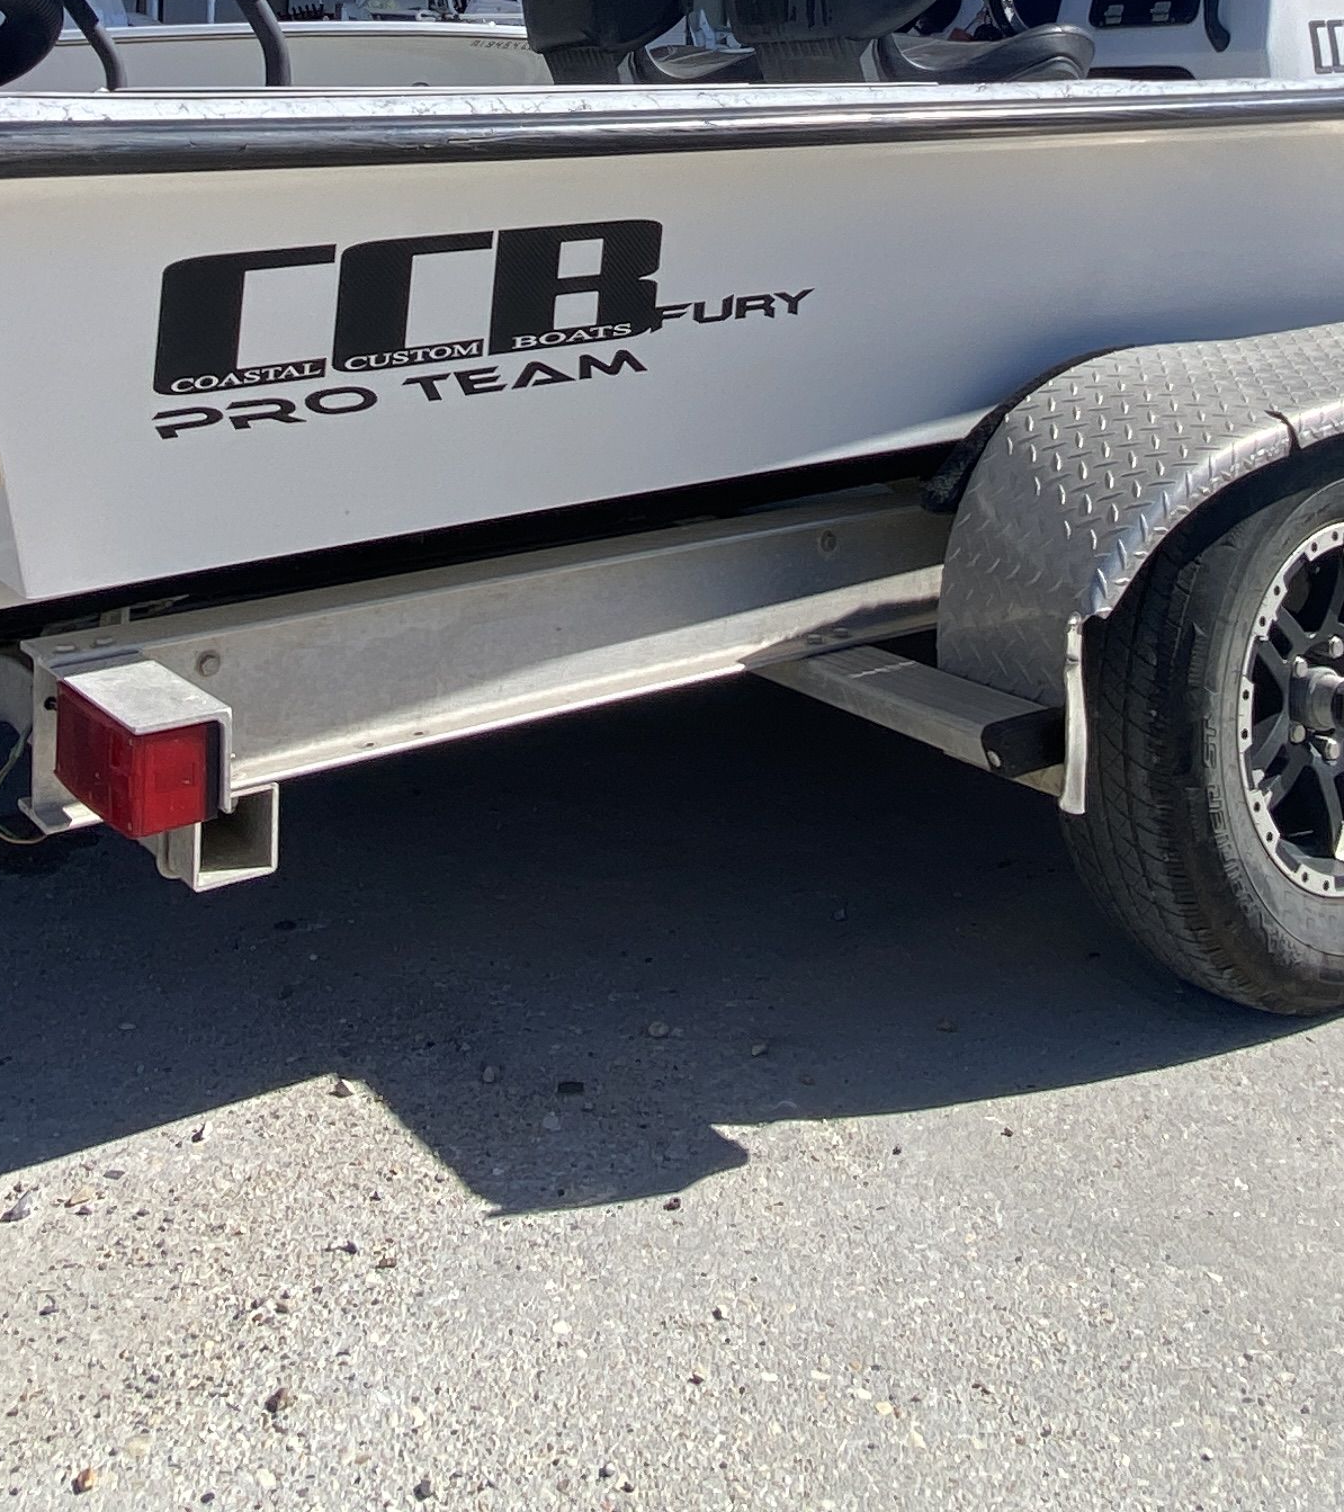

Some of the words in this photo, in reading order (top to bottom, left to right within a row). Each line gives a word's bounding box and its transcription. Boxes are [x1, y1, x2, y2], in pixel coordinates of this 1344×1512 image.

[153, 219, 663, 396] CCB
[650, 287, 816, 334] FURY
[152, 386, 378, 440] PRO
[401, 349, 648, 402] TEAM
[169, 361, 323, 394] COASTAL
[344, 342, 480, 371] CUSTOM
[511, 322, 633, 350] BOATS
